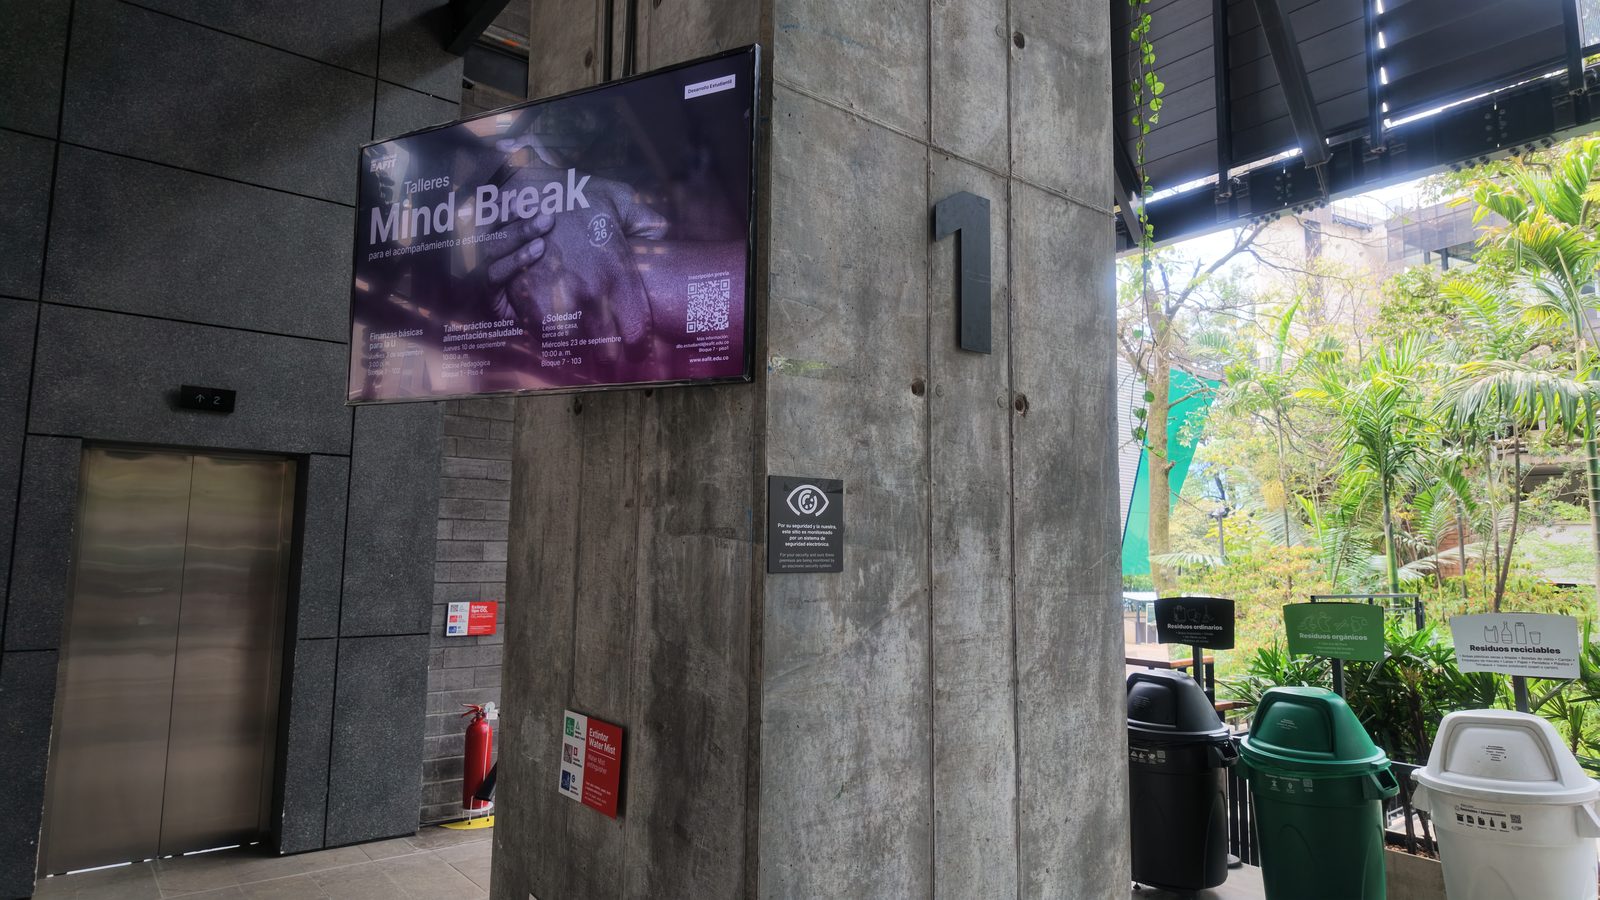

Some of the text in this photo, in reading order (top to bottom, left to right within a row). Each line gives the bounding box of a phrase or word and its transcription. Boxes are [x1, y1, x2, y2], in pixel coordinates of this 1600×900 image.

[404, 175, 450, 194] Talleres
[369, 168, 591, 245] Mind-Break
[593, 218, 606, 231] 20
[594, 229, 608, 241] 26
[368, 251, 384, 262] para
[385, 248, 392, 257] el
[392, 238, 454, 256] acompañamiento
[462, 230, 508, 245] estudiantes
[935, 190, 991, 355] 1
[542, 310, 583, 325] ¿Soledad?
[443, 319, 514, 333] Taller práctico sobre
[369, 328, 424, 341] Finanzas básicas
[442, 327, 524, 343] alimentación saludable
[369, 342, 383, 351] para
[476, 341, 506, 350] septiembre
[541, 340, 569, 348] Miércoles
[579, 338, 587, 346] de
[587, 335, 622, 346] septiembre
[541, 350, 558, 358] 10:00
[541, 359, 561, 367] Bloque
[571, 357, 582, 365] 103
[213, 396, 221, 405] 2
[1299, 632, 1368, 641] Residuos orgánicos
[1470, 644, 1561, 654] Residuos reciclables
[589, 727, 609, 742] Extintor
[588, 737, 616, 755] Water Mist
